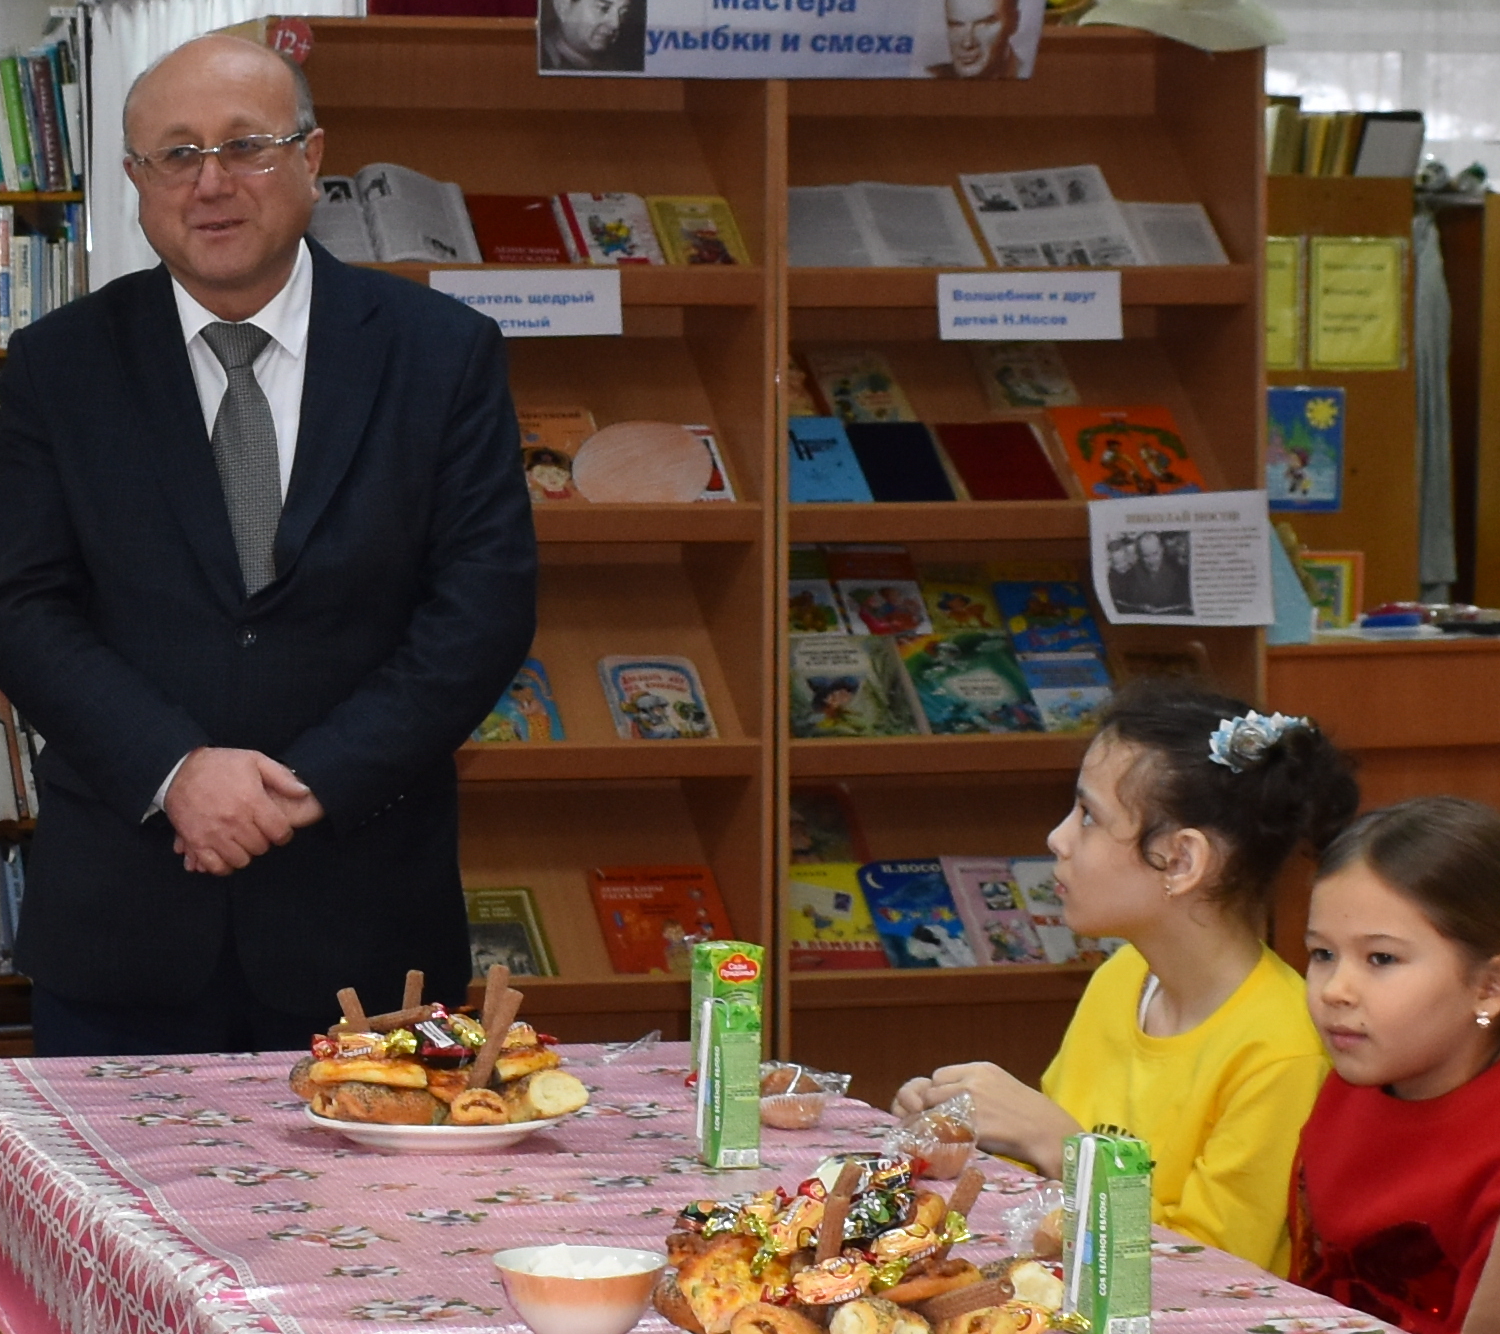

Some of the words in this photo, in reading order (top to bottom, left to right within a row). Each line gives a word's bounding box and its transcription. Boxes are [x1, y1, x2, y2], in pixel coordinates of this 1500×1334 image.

[647, 25, 772, 55] улыбки
[780, 34, 800, 52] и
[811, 33, 914, 54] смеха
[528, 291, 595, 305] щедрый
[881, 864, 941, 873] Н.НОСО
